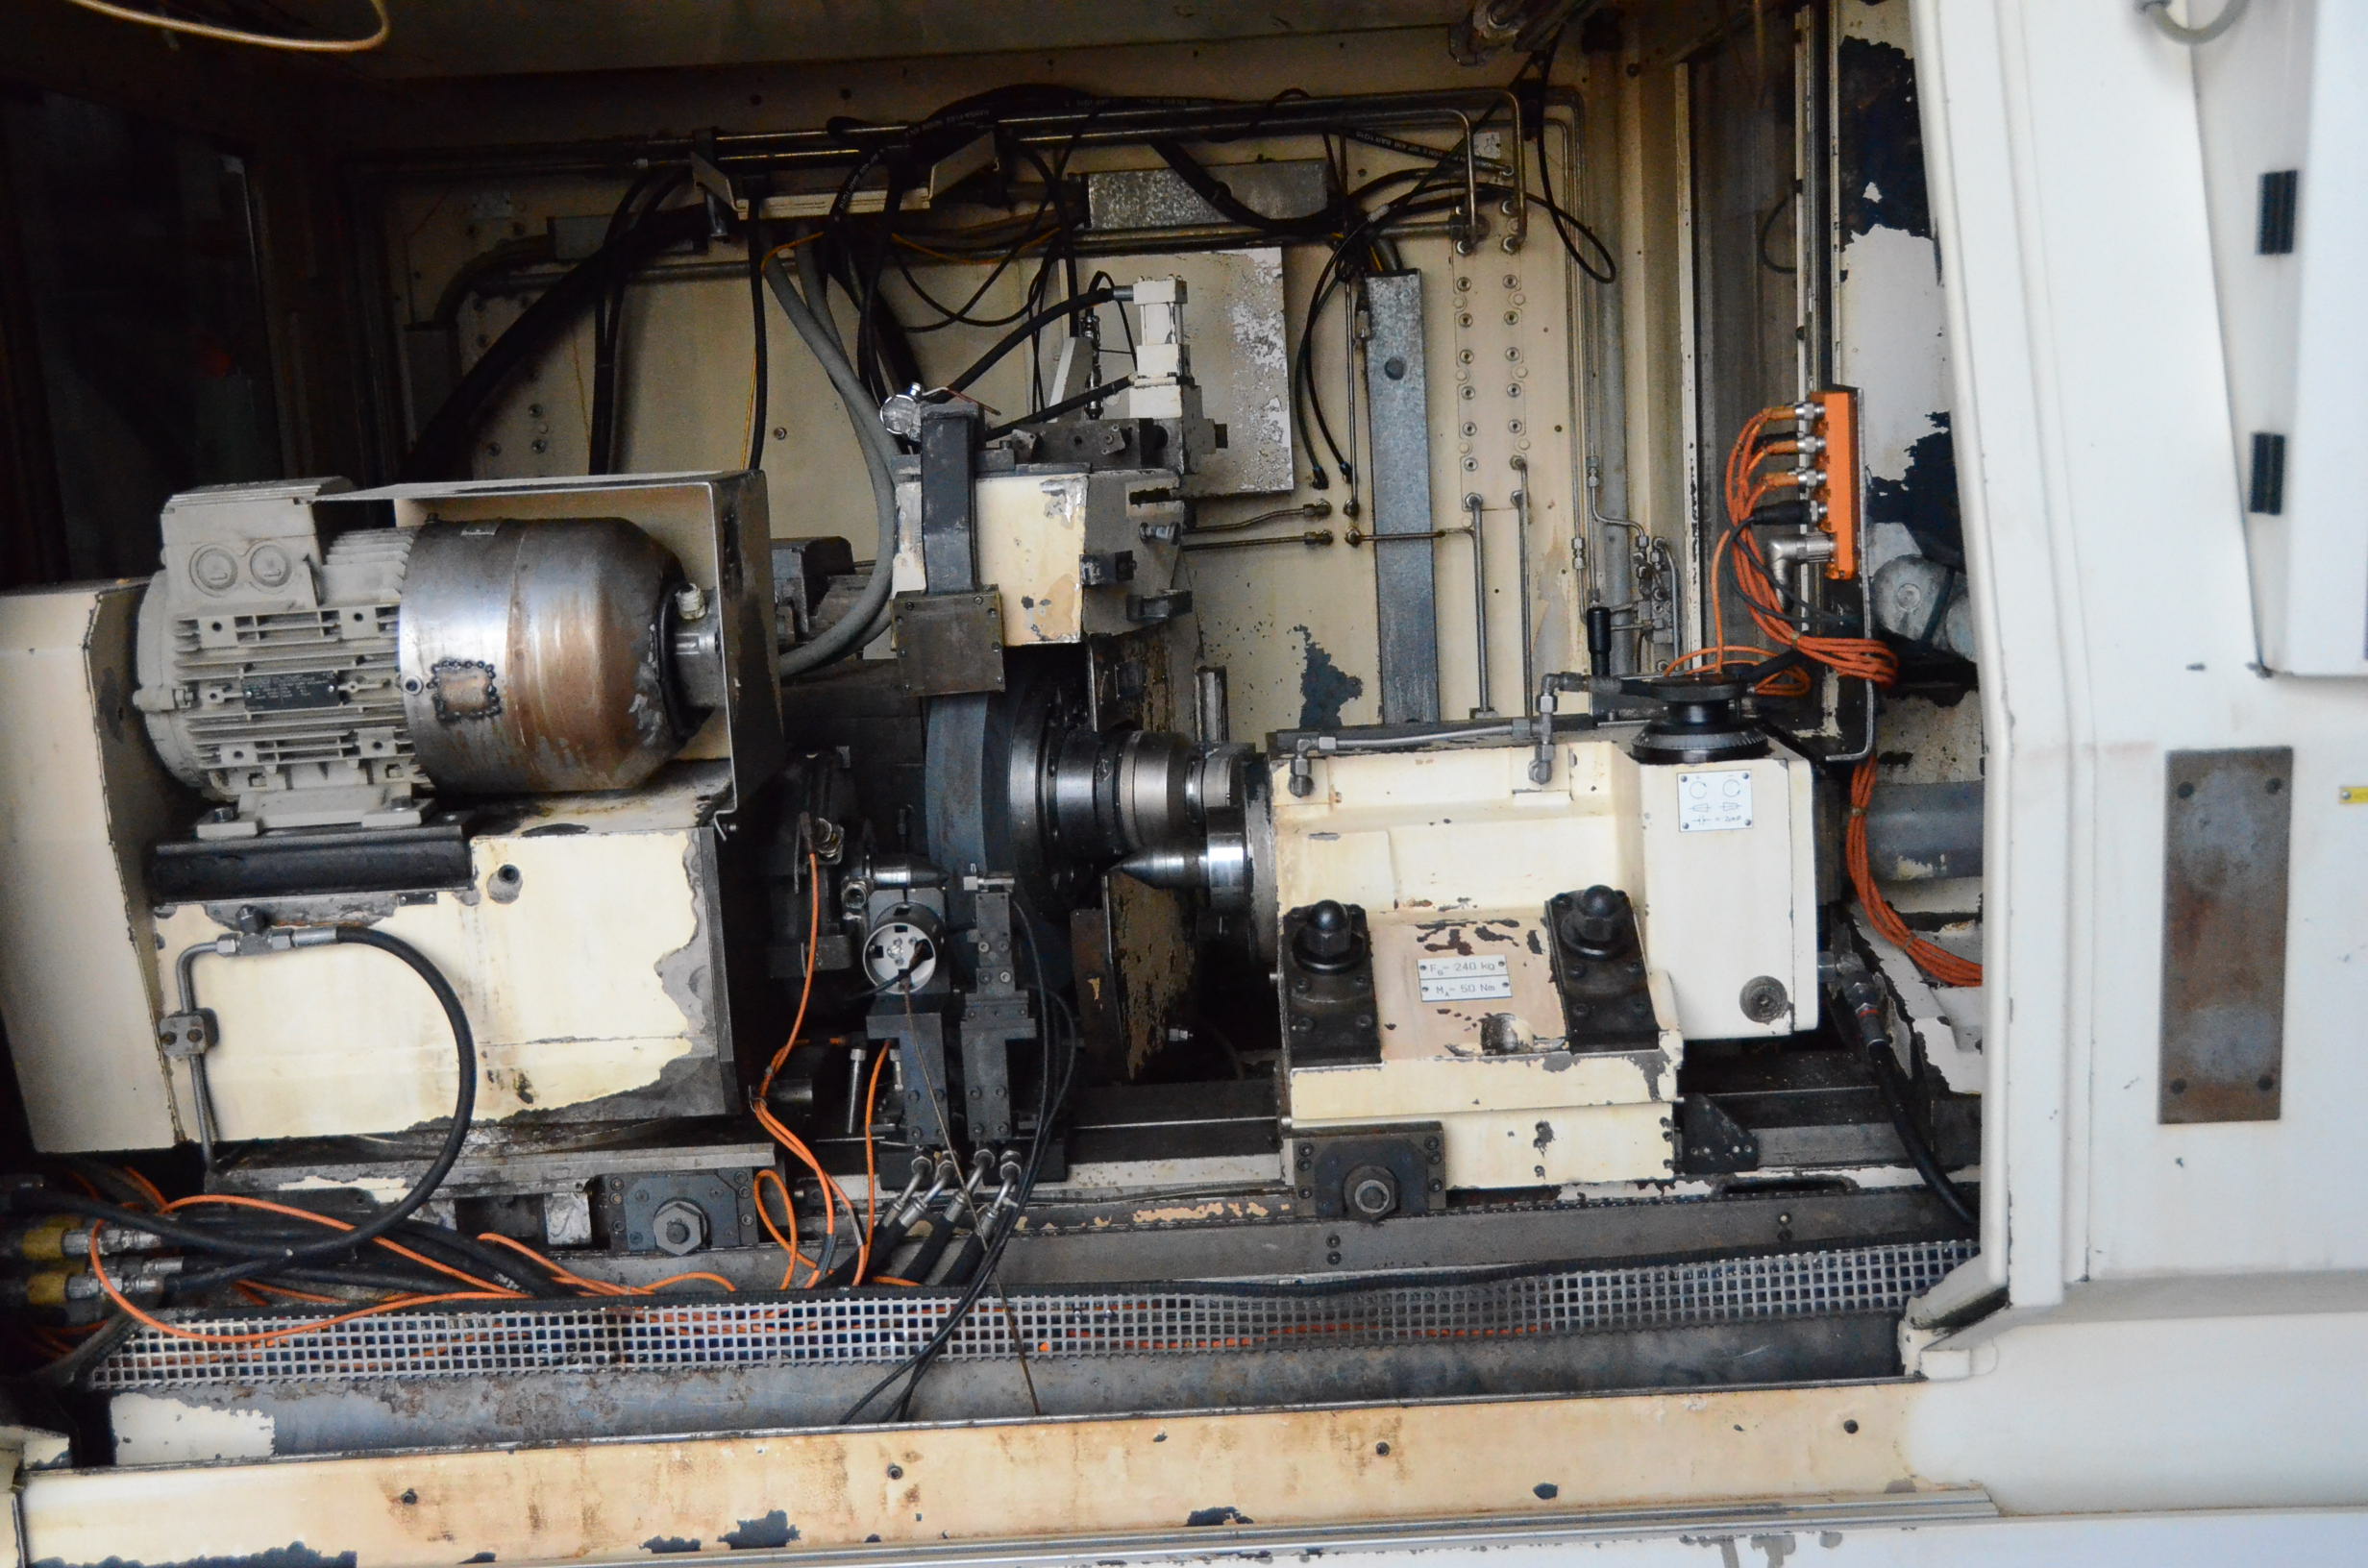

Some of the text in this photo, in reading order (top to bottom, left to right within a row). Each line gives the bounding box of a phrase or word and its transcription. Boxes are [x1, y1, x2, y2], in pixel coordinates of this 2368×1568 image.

[1454, 962, 1477, 971] 240
[1481, 961, 1495, 970] kg
[1460, 983, 1476, 992] 50
[1480, 983, 1495, 992] Nm
